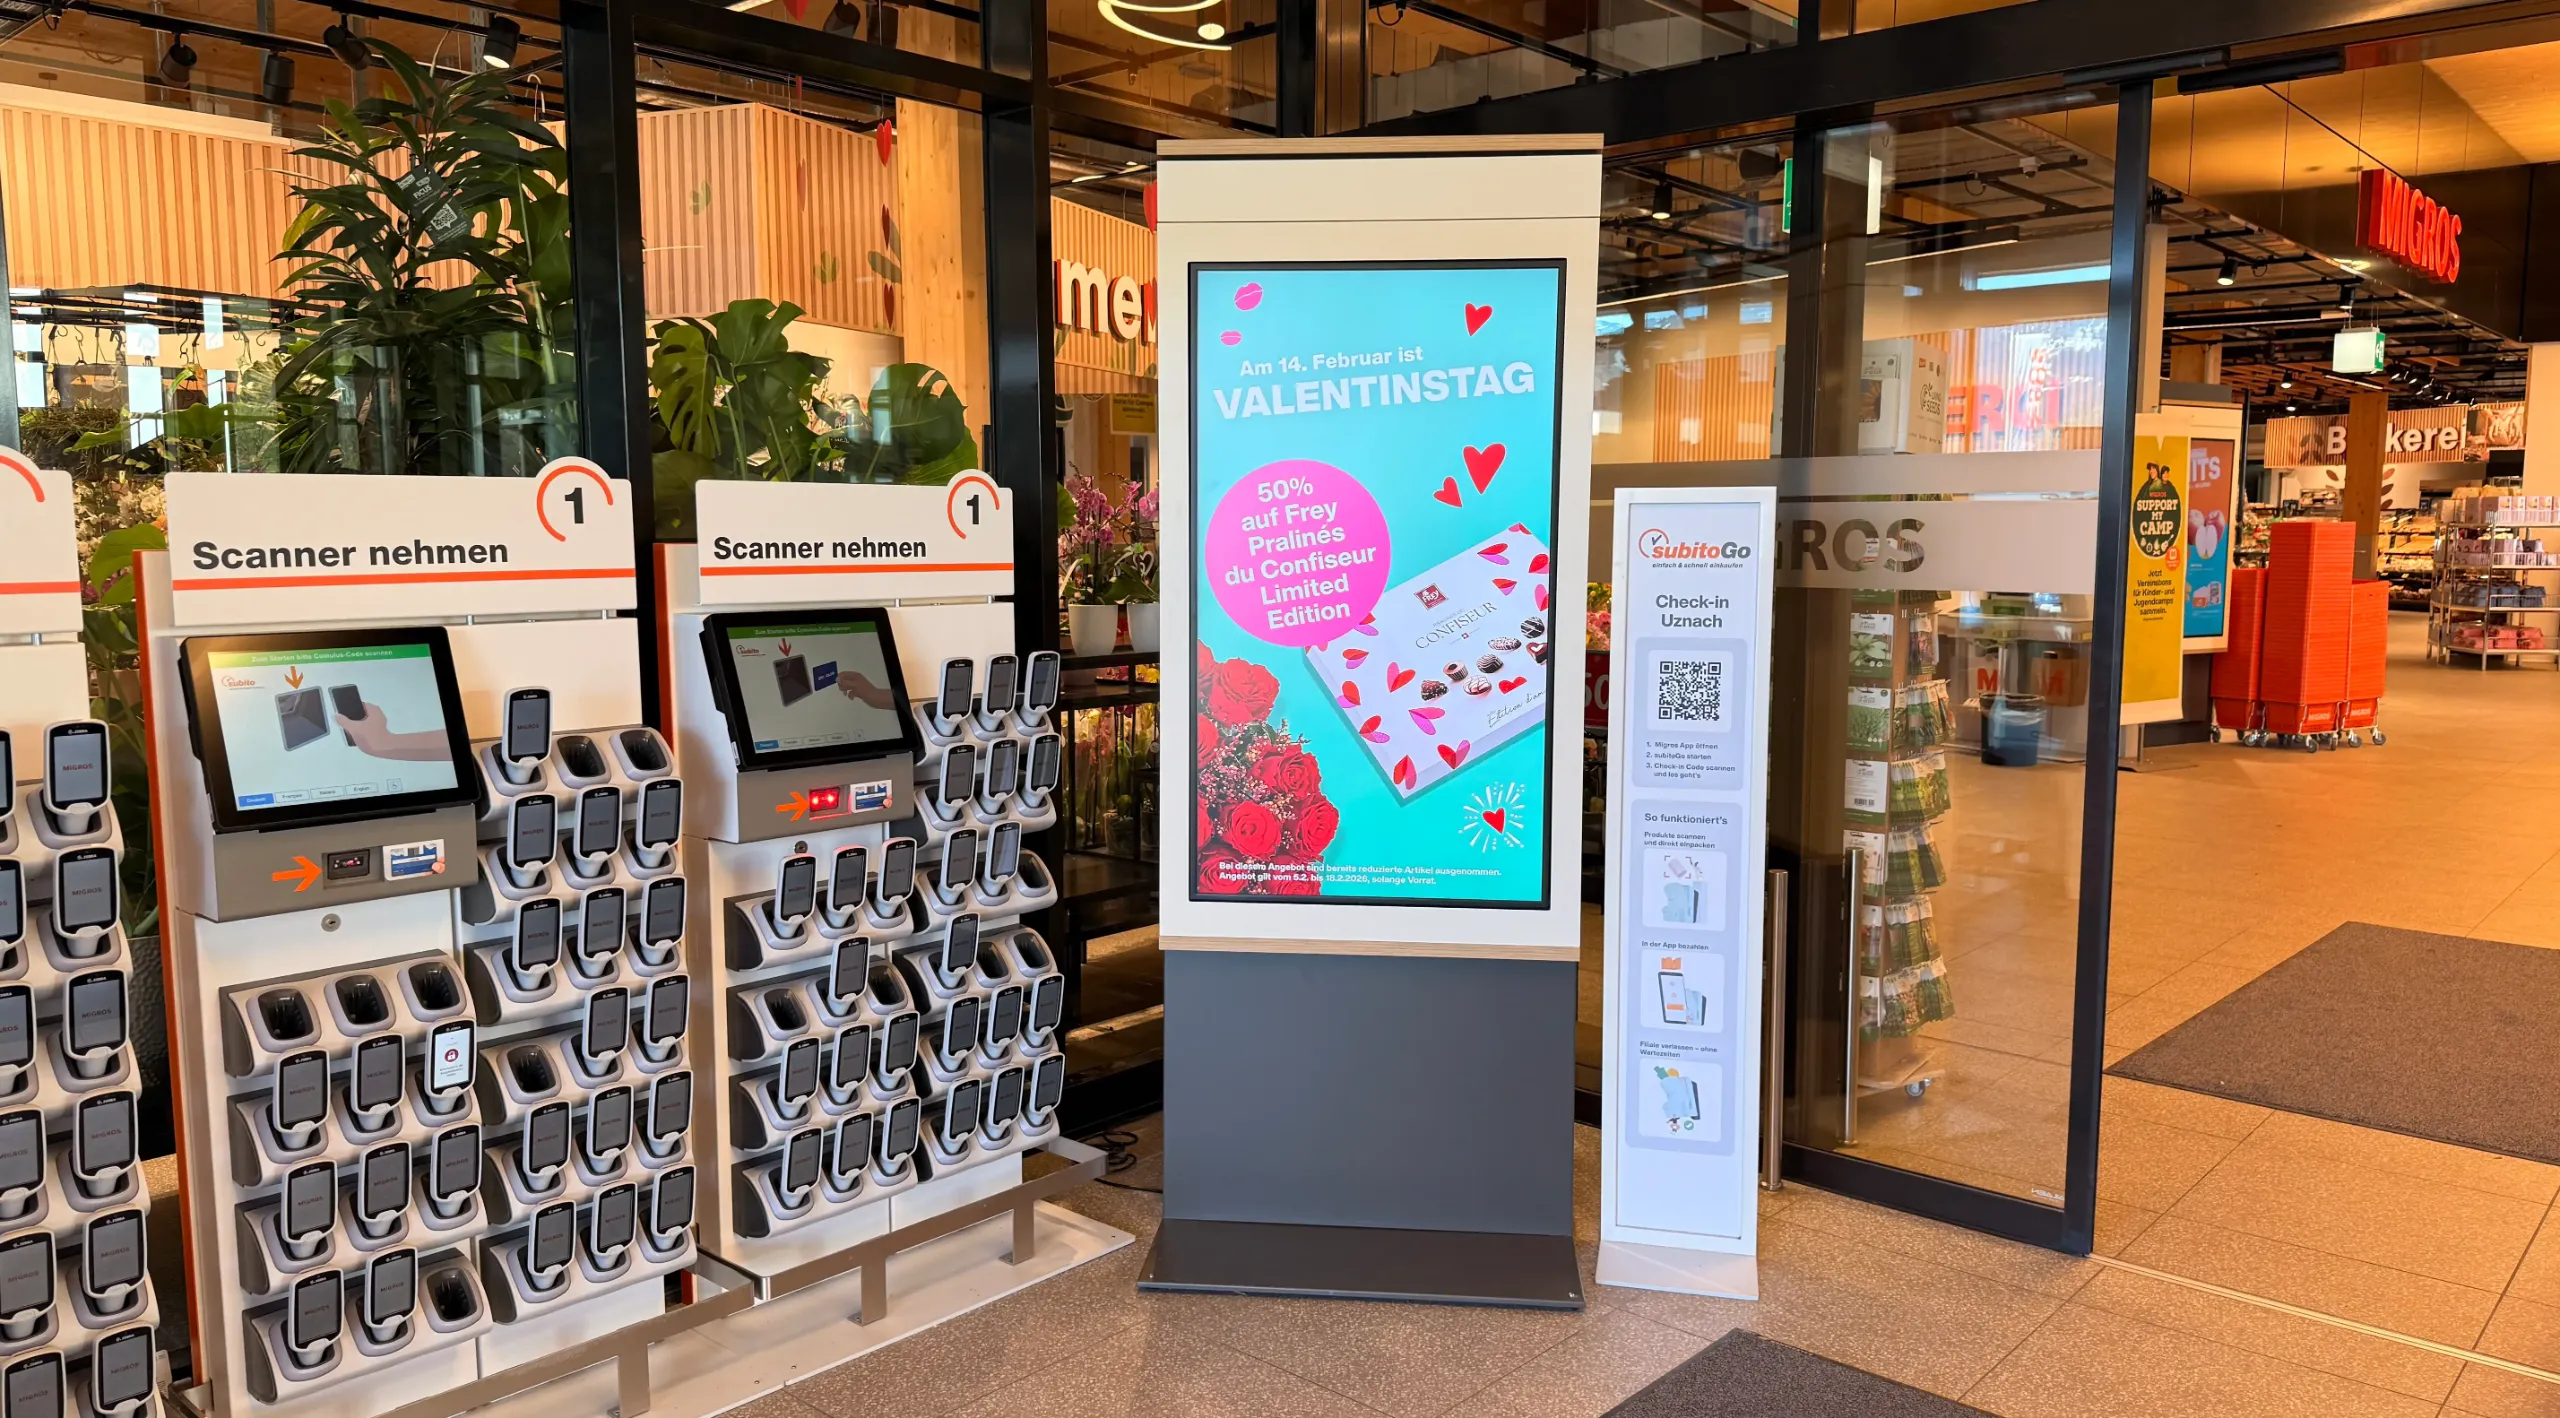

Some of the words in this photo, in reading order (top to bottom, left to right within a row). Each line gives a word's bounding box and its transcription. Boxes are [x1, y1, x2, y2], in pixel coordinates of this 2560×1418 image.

[413, 185, 432, 199] FICUS
[2379, 168, 2462, 283] MIGROS
[1240, 359, 1273, 377] Am
[1278, 356, 1306, 374] 14.
[1312, 349, 1392, 370] Februar
[1397, 346, 1424, 362] ist
[1213, 361, 1534, 420] VALENTINSTAG
[1926, 399, 1941, 416] SEEDS
[2327, 418, 2467, 455] Bkerei
[2190, 456, 2221, 482] ITS
[1258, 476, 1314, 503] 50%
[563, 486, 585, 525] 1
[966, 494, 980, 525] 1
[2137, 499, 2179, 512] SUPPORT
[1241, 507, 1279, 532] auf
[1285, 502, 1338, 525] Frey
[2151, 511, 2164, 521] MY
[2140, 520, 2174, 536] CAMP
[1248, 524, 1346, 556] Pralinés
[192, 540, 356, 570] Scanner
[369, 539, 510, 567] nehmen
[713, 536, 824, 560] Scanner
[832, 536, 927, 559] nehmen
[1652, 541, 1752, 559] subitoGo
[1225, 565, 1255, 586] du
[1260, 546, 1377, 579] Confiseur
[2148, 569, 2163, 577] Jetzt
[1260, 573, 1350, 606] Limited
[2137, 579, 2172, 587] Vereinsbons
[2133, 589, 2142, 597] für
[2142, 588, 2164, 597] Kinder-
[2164, 587, 2176, 595] und
[1655, 594, 1730, 609] Check-in
[2134, 597, 2174, 608] Jugendcamps
[1267, 602, 1351, 630] Edition
[2140, 606, 2167, 616] sammeln.
[1415, 602, 1498, 649] CONFISEUR
[1661, 613, 1723, 628] Uznach
[228, 678, 256, 688] subito
[1654, 742, 1679, 750] Migros
[1680, 742, 1694, 750] App
[1695, 742, 1718, 750] öffnen
[1646, 751, 1653, 759] 2.
[1654, 752, 1685, 760] subitoGo
[62, 763, 93, 771] MIGROS
[1644, 812, 1658, 822] So
[1660, 813, 1728, 825] funktioniert's
[1644, 831, 1676, 839] Produkte
[1219, 861, 1234, 870] Bei
[1235, 861, 1266, 870] diesem
[1268, 862, 1305, 872] Angebot
[1306, 862, 1325, 872] sind
[1326, 863, 1357, 872] bereits
[1358, 865, 1403, 873] reduzierte
[1404, 865, 1434, 874] Artikel
[1435, 867, 1502, 876] ausgenommen.
[1219, 871, 1256, 881] Angebot
[1257, 872, 1271, 882] gilt
[1293, 873, 1309, 881] 5.2.
[1311, 873, 1324, 882] bis
[1325, 874, 1371, 884] 18.2.2026,
[1371, 875, 1406, 885] solange
[1408, 876, 1437, 884] Vorrat.
[71, 887, 102, 897] MIGROS
[1662, 942, 1677, 950] App
[1678, 943, 1709, 951] bezahlen
[81, 1008, 112, 1019] MIGROS
[1639, 1040, 1660, 1049] Filiale
[1661, 1043, 1694, 1051] verlassen
[1639, 1049, 1681, 1058] Wartezeiten
[90, 1128, 122, 1140] MIGROS
[100, 1246, 131, 1259] MIGROS
[8, 1270, 40, 1283] MIGROS
[110, 1362, 140, 1375] MIGROS
[18, 1390, 49, 1403] MIGROS
